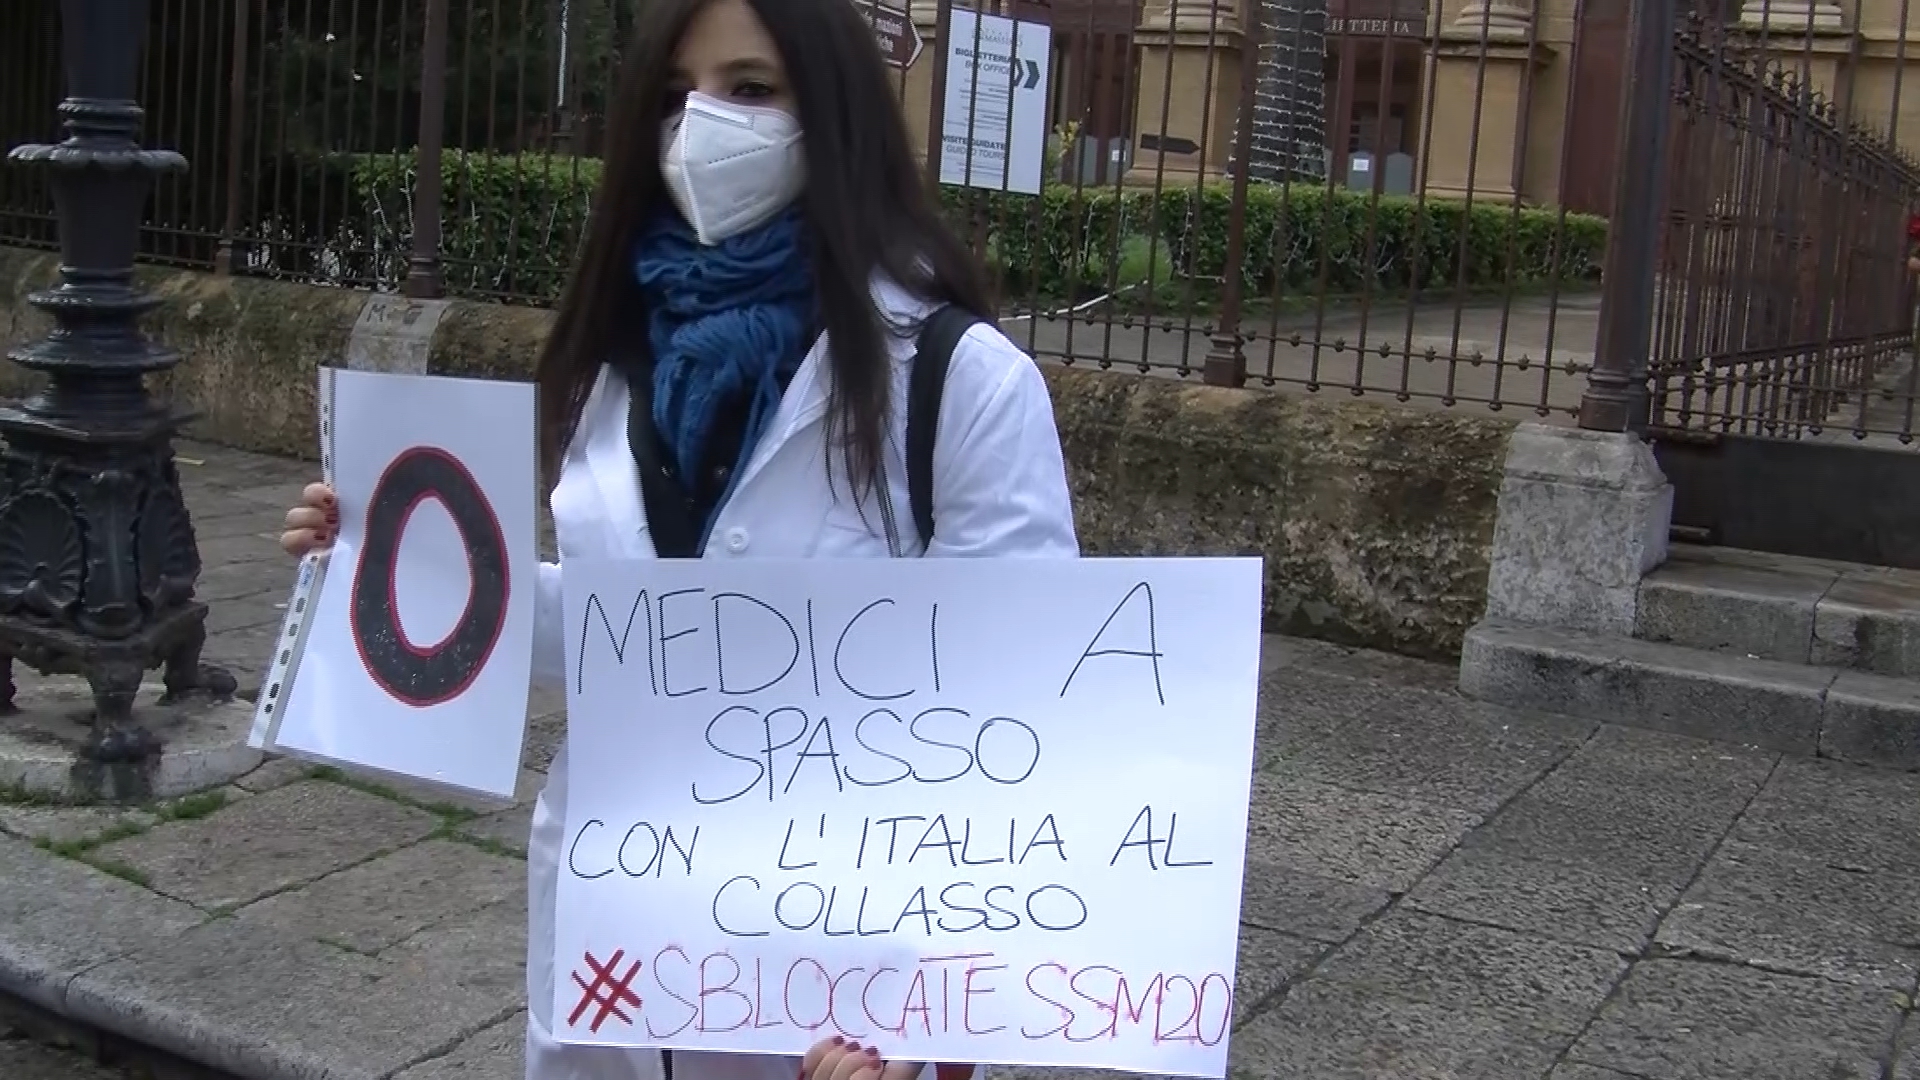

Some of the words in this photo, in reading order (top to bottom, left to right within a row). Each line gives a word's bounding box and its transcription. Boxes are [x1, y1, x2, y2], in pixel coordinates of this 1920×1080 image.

[577, 587, 940, 700] MEDICI
[1060, 581, 1165, 706] A
[692, 706, 1040, 804] SPASSO
[568, 819, 700, 879] CON
[1110, 805, 1214, 868] AL
[713, 876, 1087, 936] COLLASSO
